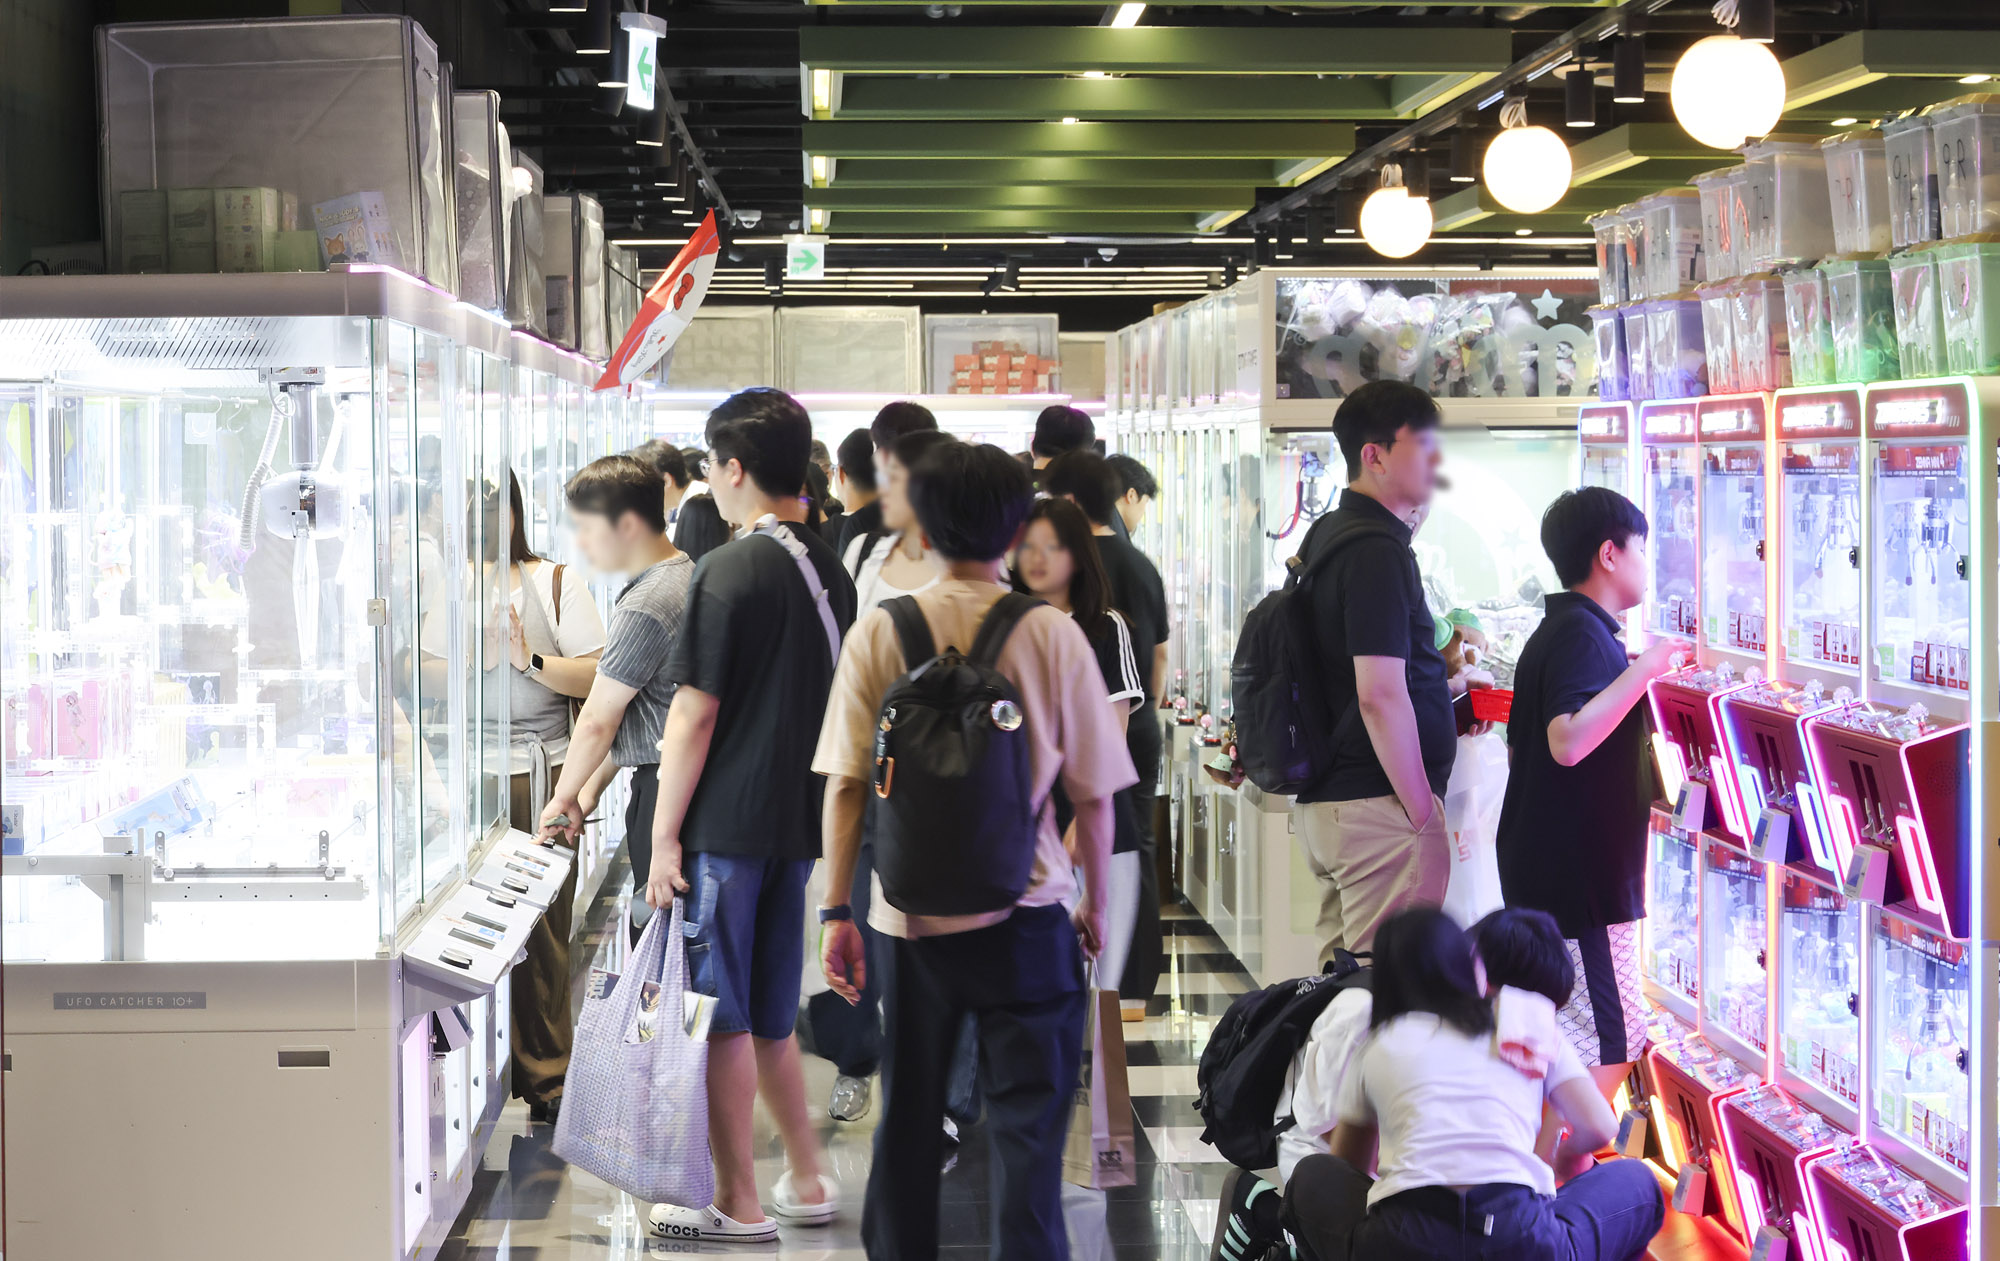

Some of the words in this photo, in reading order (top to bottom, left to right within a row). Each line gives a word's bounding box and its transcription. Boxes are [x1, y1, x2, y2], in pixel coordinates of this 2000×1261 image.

[66, 997, 92, 1007] UFO
[100, 997, 165, 1007] CATCHER
[172, 996, 194, 1007] 10+
[657, 1222, 701, 1238] crocs
